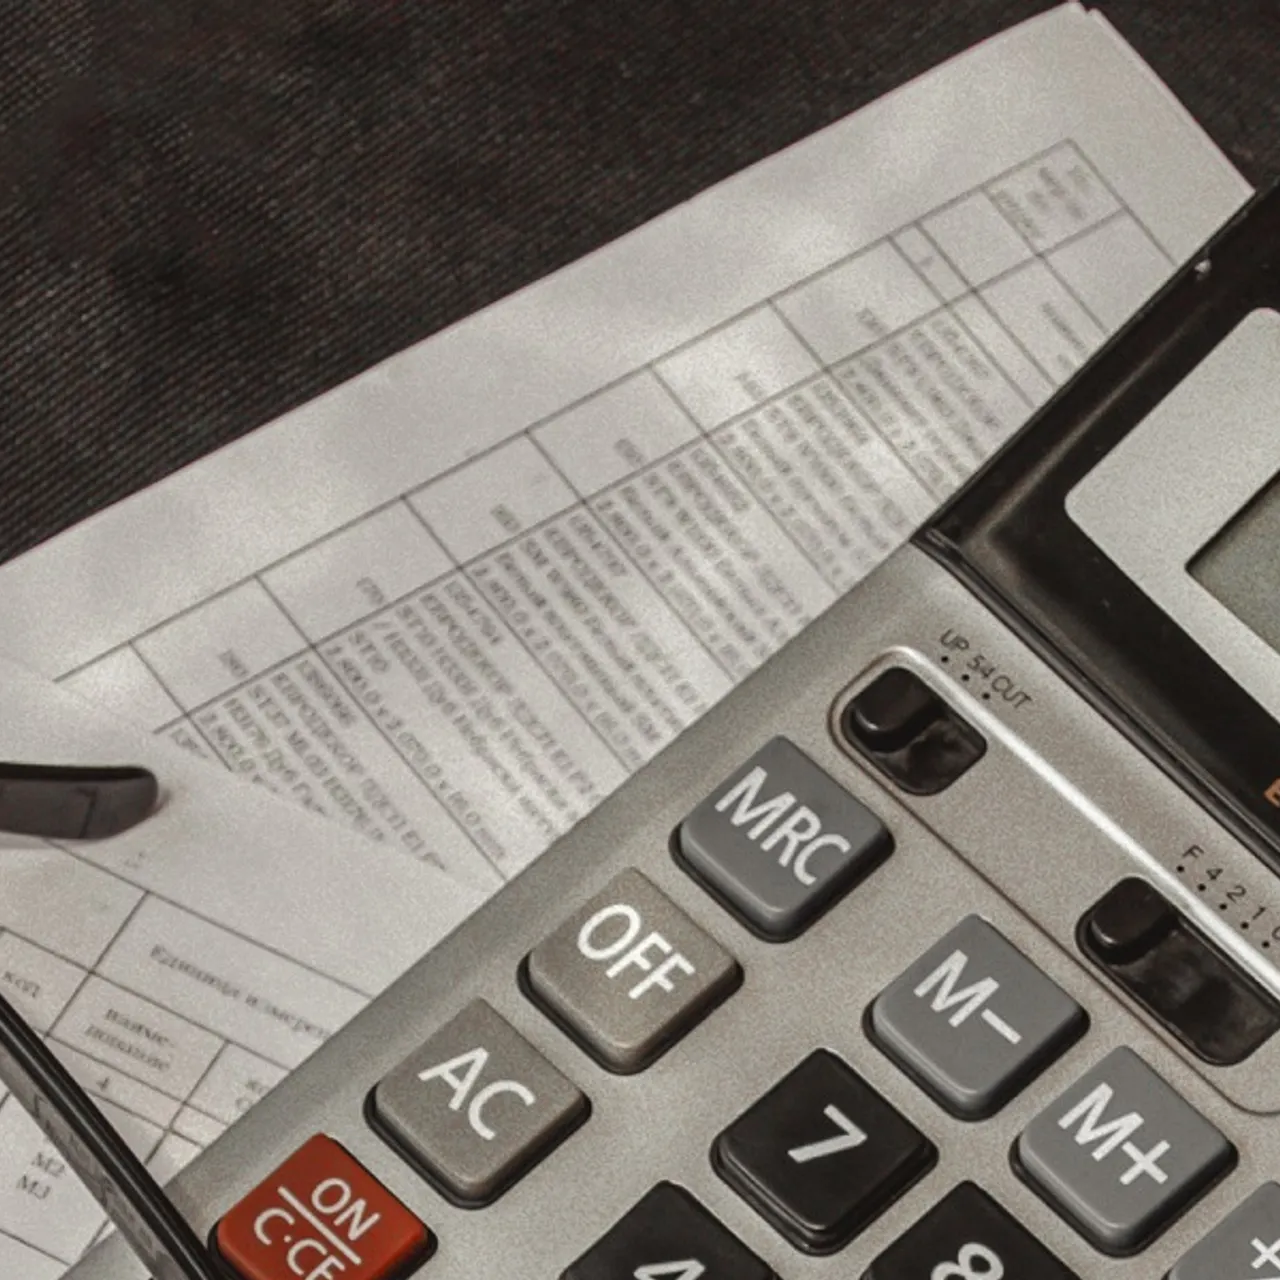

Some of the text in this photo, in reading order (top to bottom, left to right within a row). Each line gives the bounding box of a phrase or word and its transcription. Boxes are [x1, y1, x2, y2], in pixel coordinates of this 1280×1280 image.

[938, 626, 972, 657] UP
[990, 673, 1034, 713] CUT
[714, 766, 852, 886] MRC
[1182, 843, 1205, 864] F
[1206, 865, 1225, 885] 4
[1225, 883, 1248, 904] 2
[1252, 893, 1267, 911] 1
[576, 904, 697, 1001] OFF
[913, 949, 1022, 1047] M-
[417, 1047, 537, 1142] AC
[786, 1103, 869, 1165] 7
[1057, 1082, 1170, 1189] M+
[309, 1176, 381, 1242] ON
